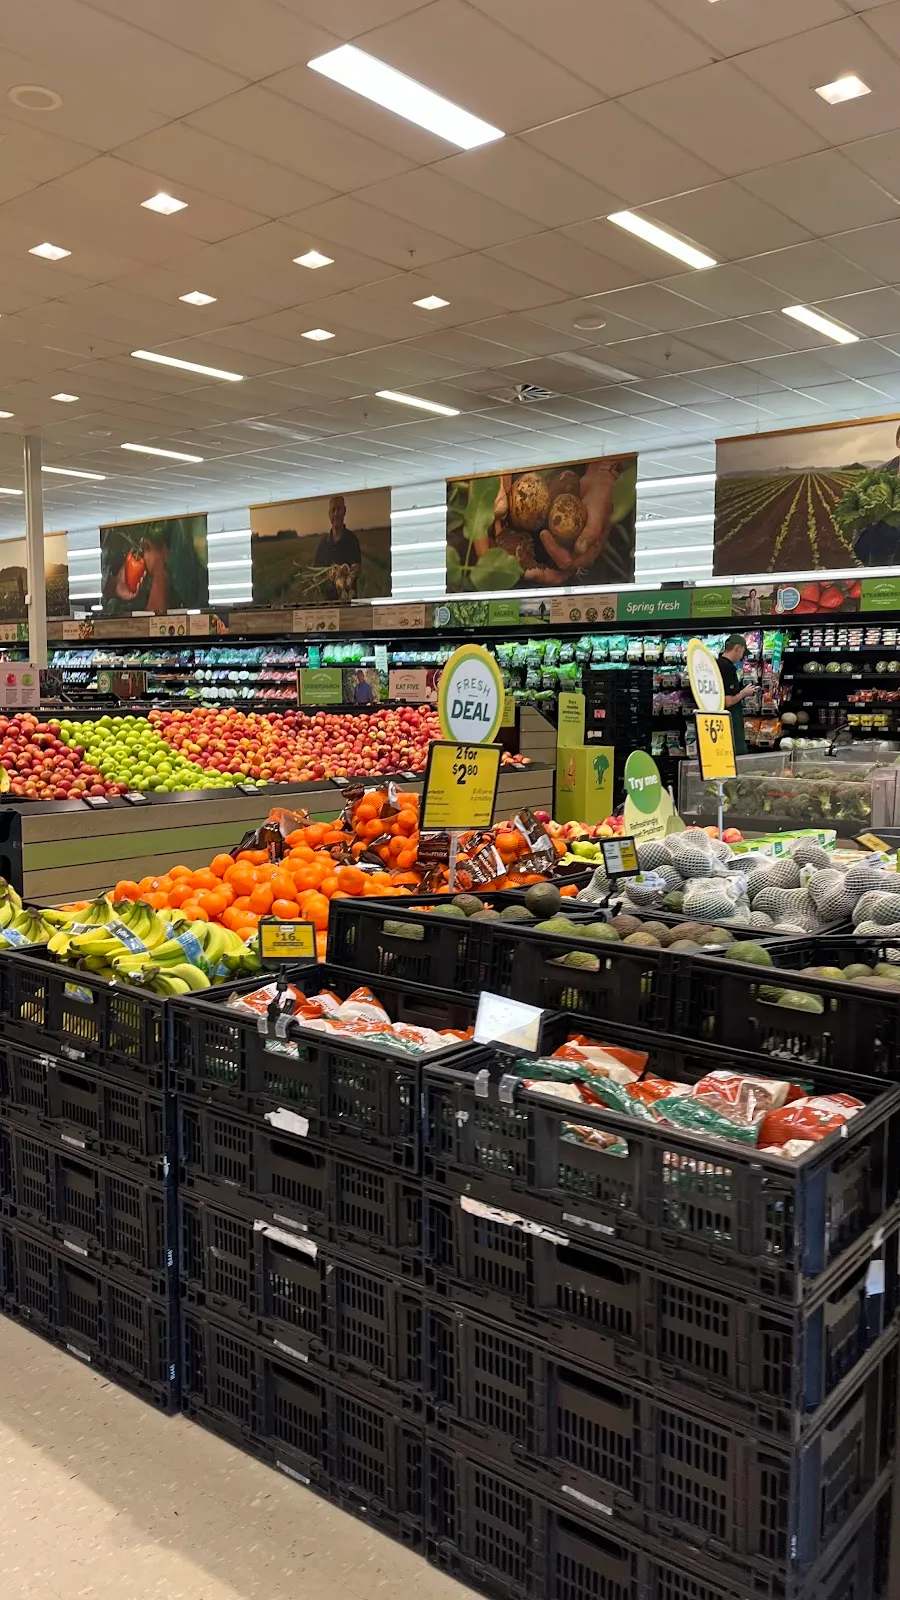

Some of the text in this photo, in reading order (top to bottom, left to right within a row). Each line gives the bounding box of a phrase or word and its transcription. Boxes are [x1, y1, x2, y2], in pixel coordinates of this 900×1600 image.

[626, 600, 680, 614] Spring fresh
[456, 678, 491, 697] FRESH
[697, 679, 719, 695] DEAL
[451, 699, 491, 722] DEAL
[456, 746, 478, 760] 2 for
[628, 774, 658, 791] Try me
